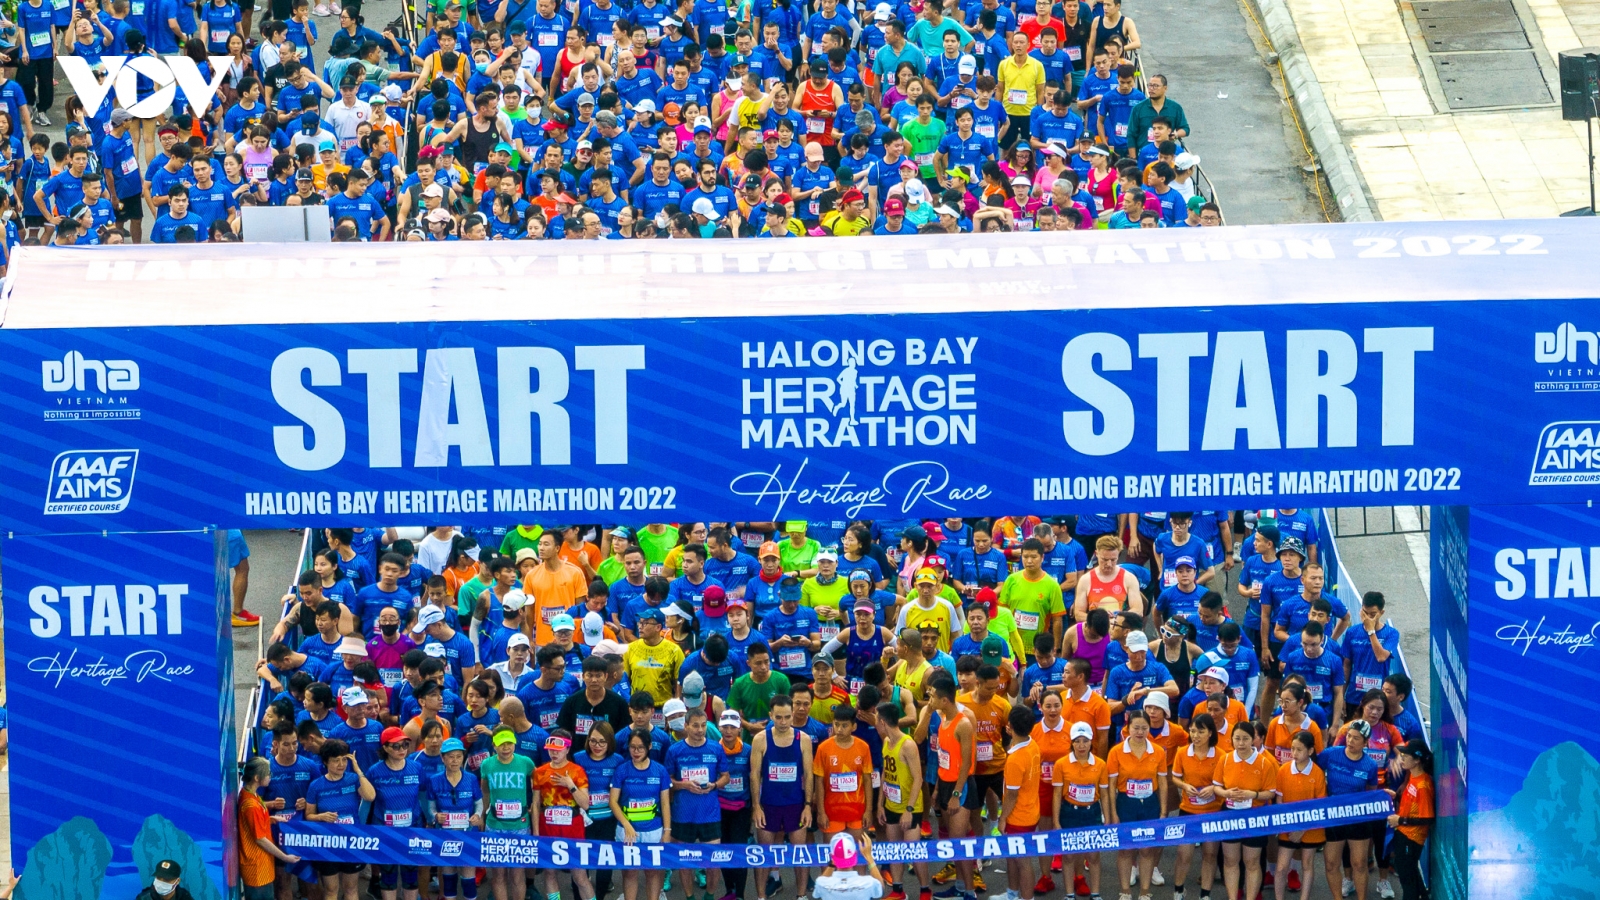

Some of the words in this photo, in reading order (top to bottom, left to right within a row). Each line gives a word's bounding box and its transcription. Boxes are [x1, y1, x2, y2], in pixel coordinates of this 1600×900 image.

[85, 257, 378, 281] HALONG
[557, 249, 907, 275] HERITAGE
[926, 238, 1336, 269] MARATHON
[1353, 234, 1549, 258] 2022
[742, 339, 895, 369] HALONG
[906, 337, 978, 365] BAY
[57, 397, 128, 405] VIETNAM
[1062, 327, 1434, 456] START
[44, 411, 80, 420] Nothing
[82, 410, 90, 418] is
[271, 345, 645, 471] START
[741, 413, 976, 449] MARATHON
[1545, 428, 1600, 448] IAA
[58, 456, 131, 477] IAAF
[55, 477, 122, 499] AIMS
[730, 457, 887, 522] Heritage
[883, 461, 992, 513] Race
[1034, 476, 1118, 500] HALONG
[1125, 475, 1165, 497] BAY
[1171, 473, 1273, 496] HERITAGE
[1279, 470, 1398, 494] MARATHON
[1405, 468, 1460, 490] 2022
[1533, 475, 1572, 483] CERTIFIED
[47, 504, 88, 512] CERTIFIED
[89, 503, 121, 511] COURSE
[246, 492, 331, 514] HALONG
[338, 492, 378, 513] BAY
[384, 490, 487, 513] HERITAGE
[494, 488, 613, 511] MARATHON
[620, 487, 676, 509] 2022
[28, 584, 189, 638] START
[1496, 616, 1594, 656] Heritage
[28, 648, 128, 688] Heritage
[124, 650, 195, 681] Race
[487, 771, 526, 790] NIKE
[1201, 817, 1247, 834] HALONG
[1248, 815, 1270, 829] BAY
[1271, 809, 1326, 826] HERITAGE
[1327, 800, 1391, 819] MARATHON
[284, 833, 348, 849] MARATHON
[349, 836, 380, 851] 2022
[480, 837, 519, 846] HALONG
[520, 839, 539, 847] BAY
[936, 833, 1049, 859] START
[1060, 829, 1098, 839] HALONG
[551, 840, 665, 867] START
[746, 843, 831, 866] STAR
[1061, 841, 1120, 852] MARATHON
[480, 854, 539, 864] MARATHON
